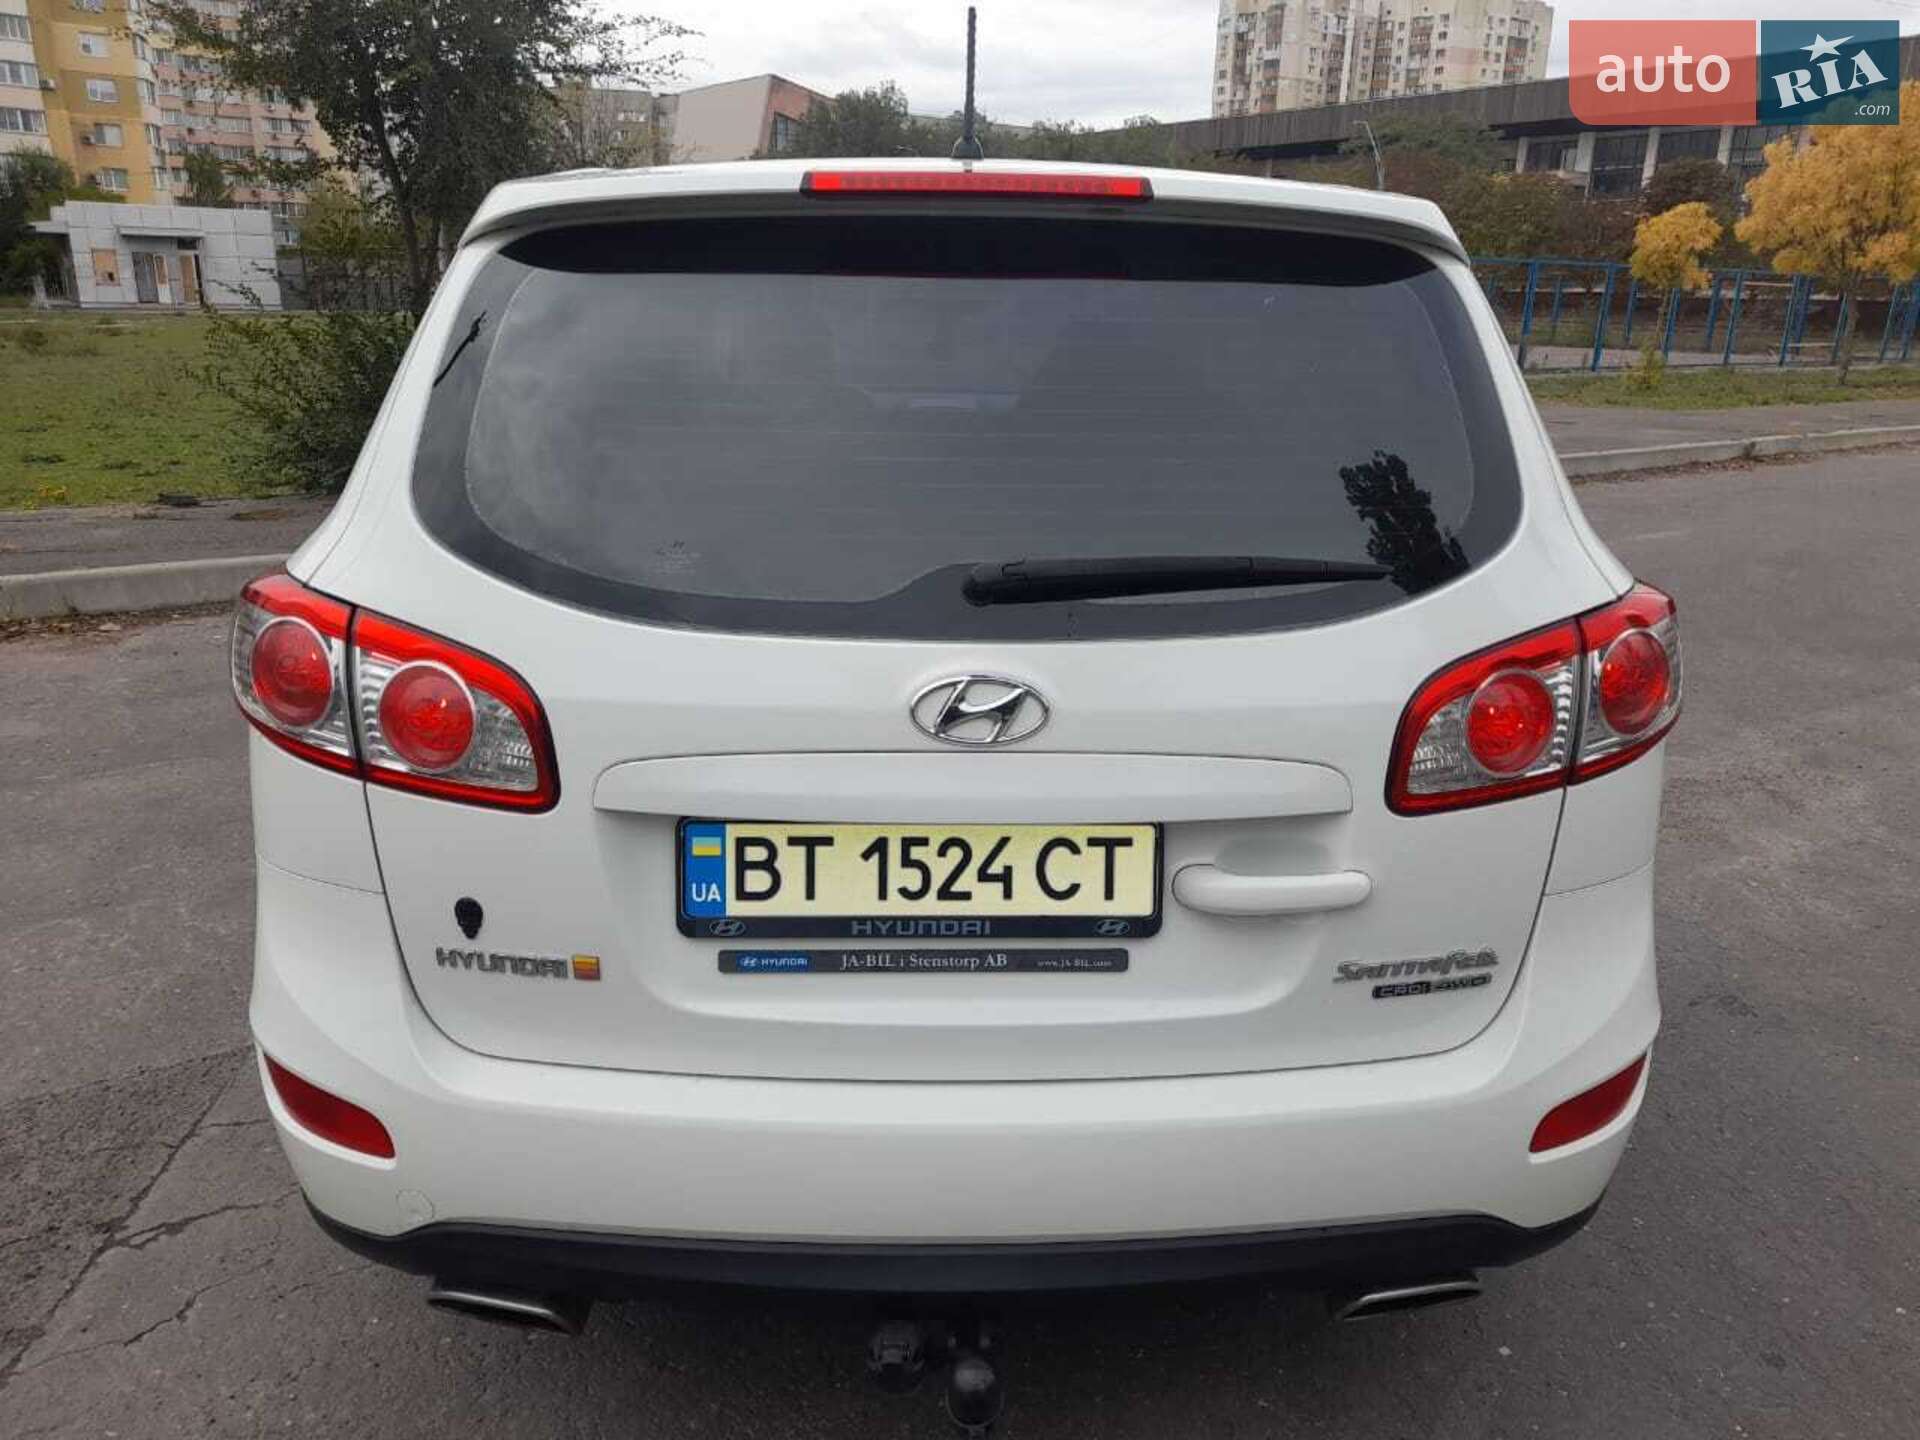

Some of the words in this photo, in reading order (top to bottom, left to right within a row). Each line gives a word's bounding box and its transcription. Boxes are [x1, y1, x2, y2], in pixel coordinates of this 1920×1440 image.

[734, 836, 834, 900] BT
[860, 836, 1013, 900] 1524
[1035, 836, 1134, 900] CT
[691, 883, 721, 902] UA
[851, 920, 991, 936] HYUNDAI
[435, 946, 569, 980] HYUNDAI
[761, 958, 808, 967] HYUNDAI
[840, 954, 896, 970] JA-BIL
[909, 953, 980, 969] Stenstorp
[984, 953, 1008, 967] AB
